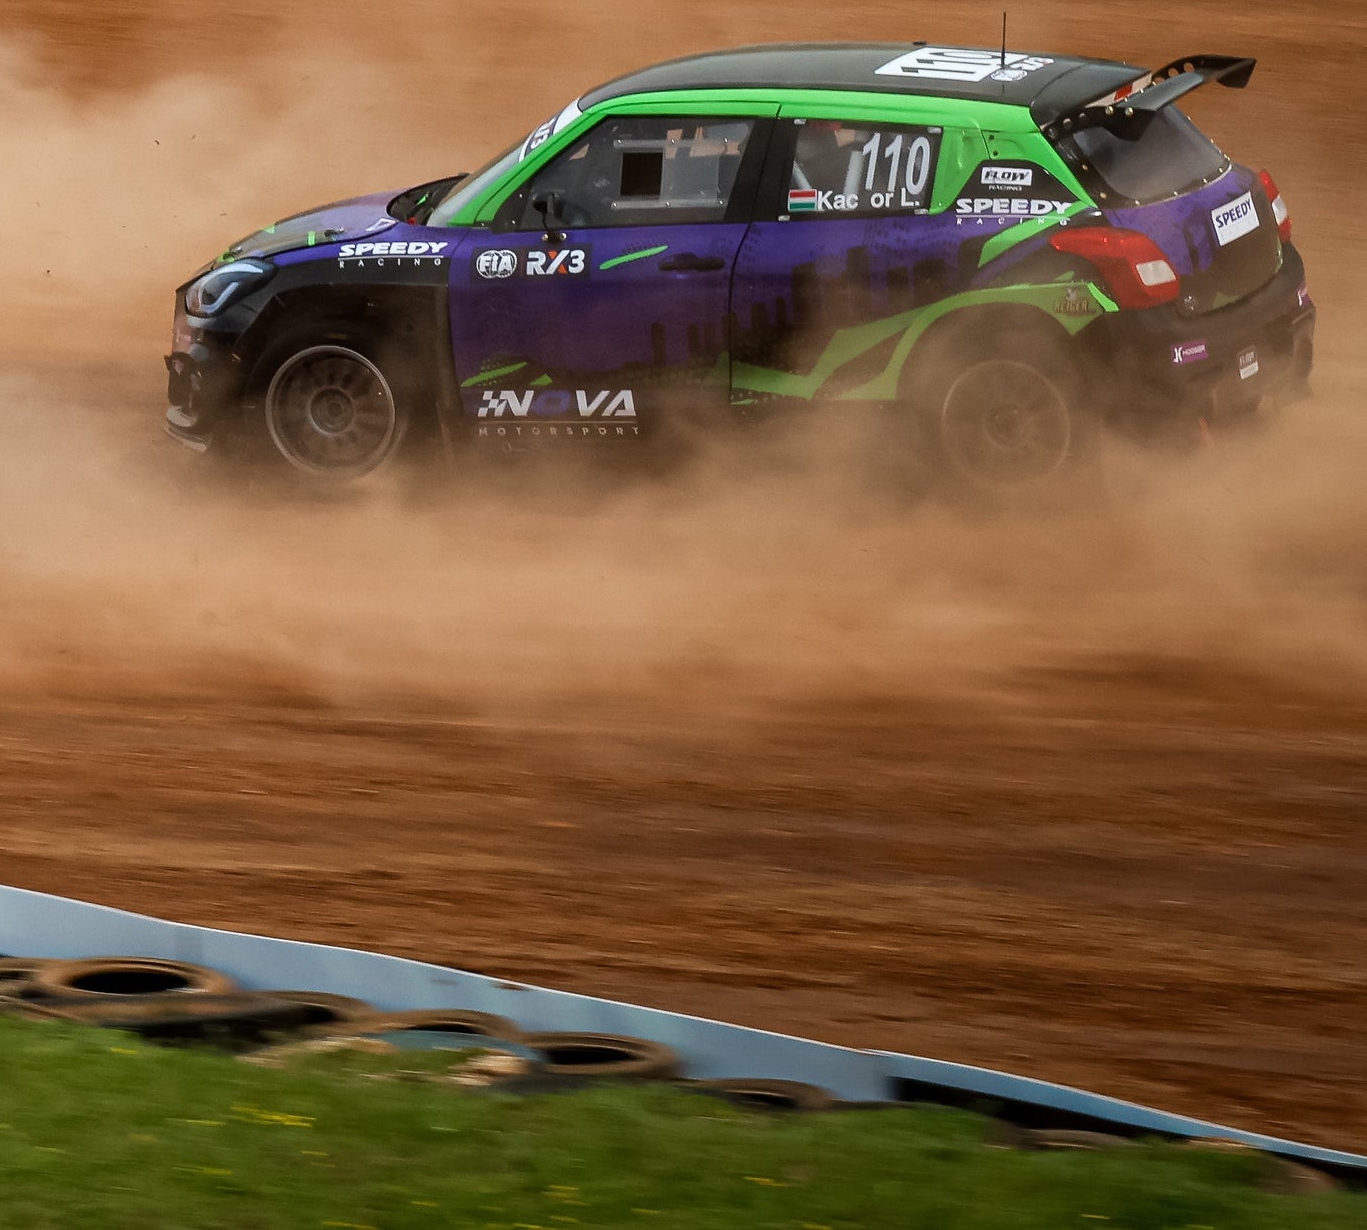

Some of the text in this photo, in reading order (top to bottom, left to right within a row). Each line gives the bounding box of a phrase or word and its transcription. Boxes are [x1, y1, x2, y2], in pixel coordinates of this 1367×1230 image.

[862, 132, 931, 196] 110
[984, 170, 1030, 182] FLOW
[901, 187, 920, 207] L.
[956, 198, 1072, 215] SPEEDY
[1215, 198, 1252, 229] SPEEDY
[956, 217, 1068, 226] RACING
[338, 241, 449, 257] SPEEDY
[339, 257, 443, 268] RACING
[477, 249, 586, 275] FIA RX3
[478, 427, 639, 436] MOTORSPORT
